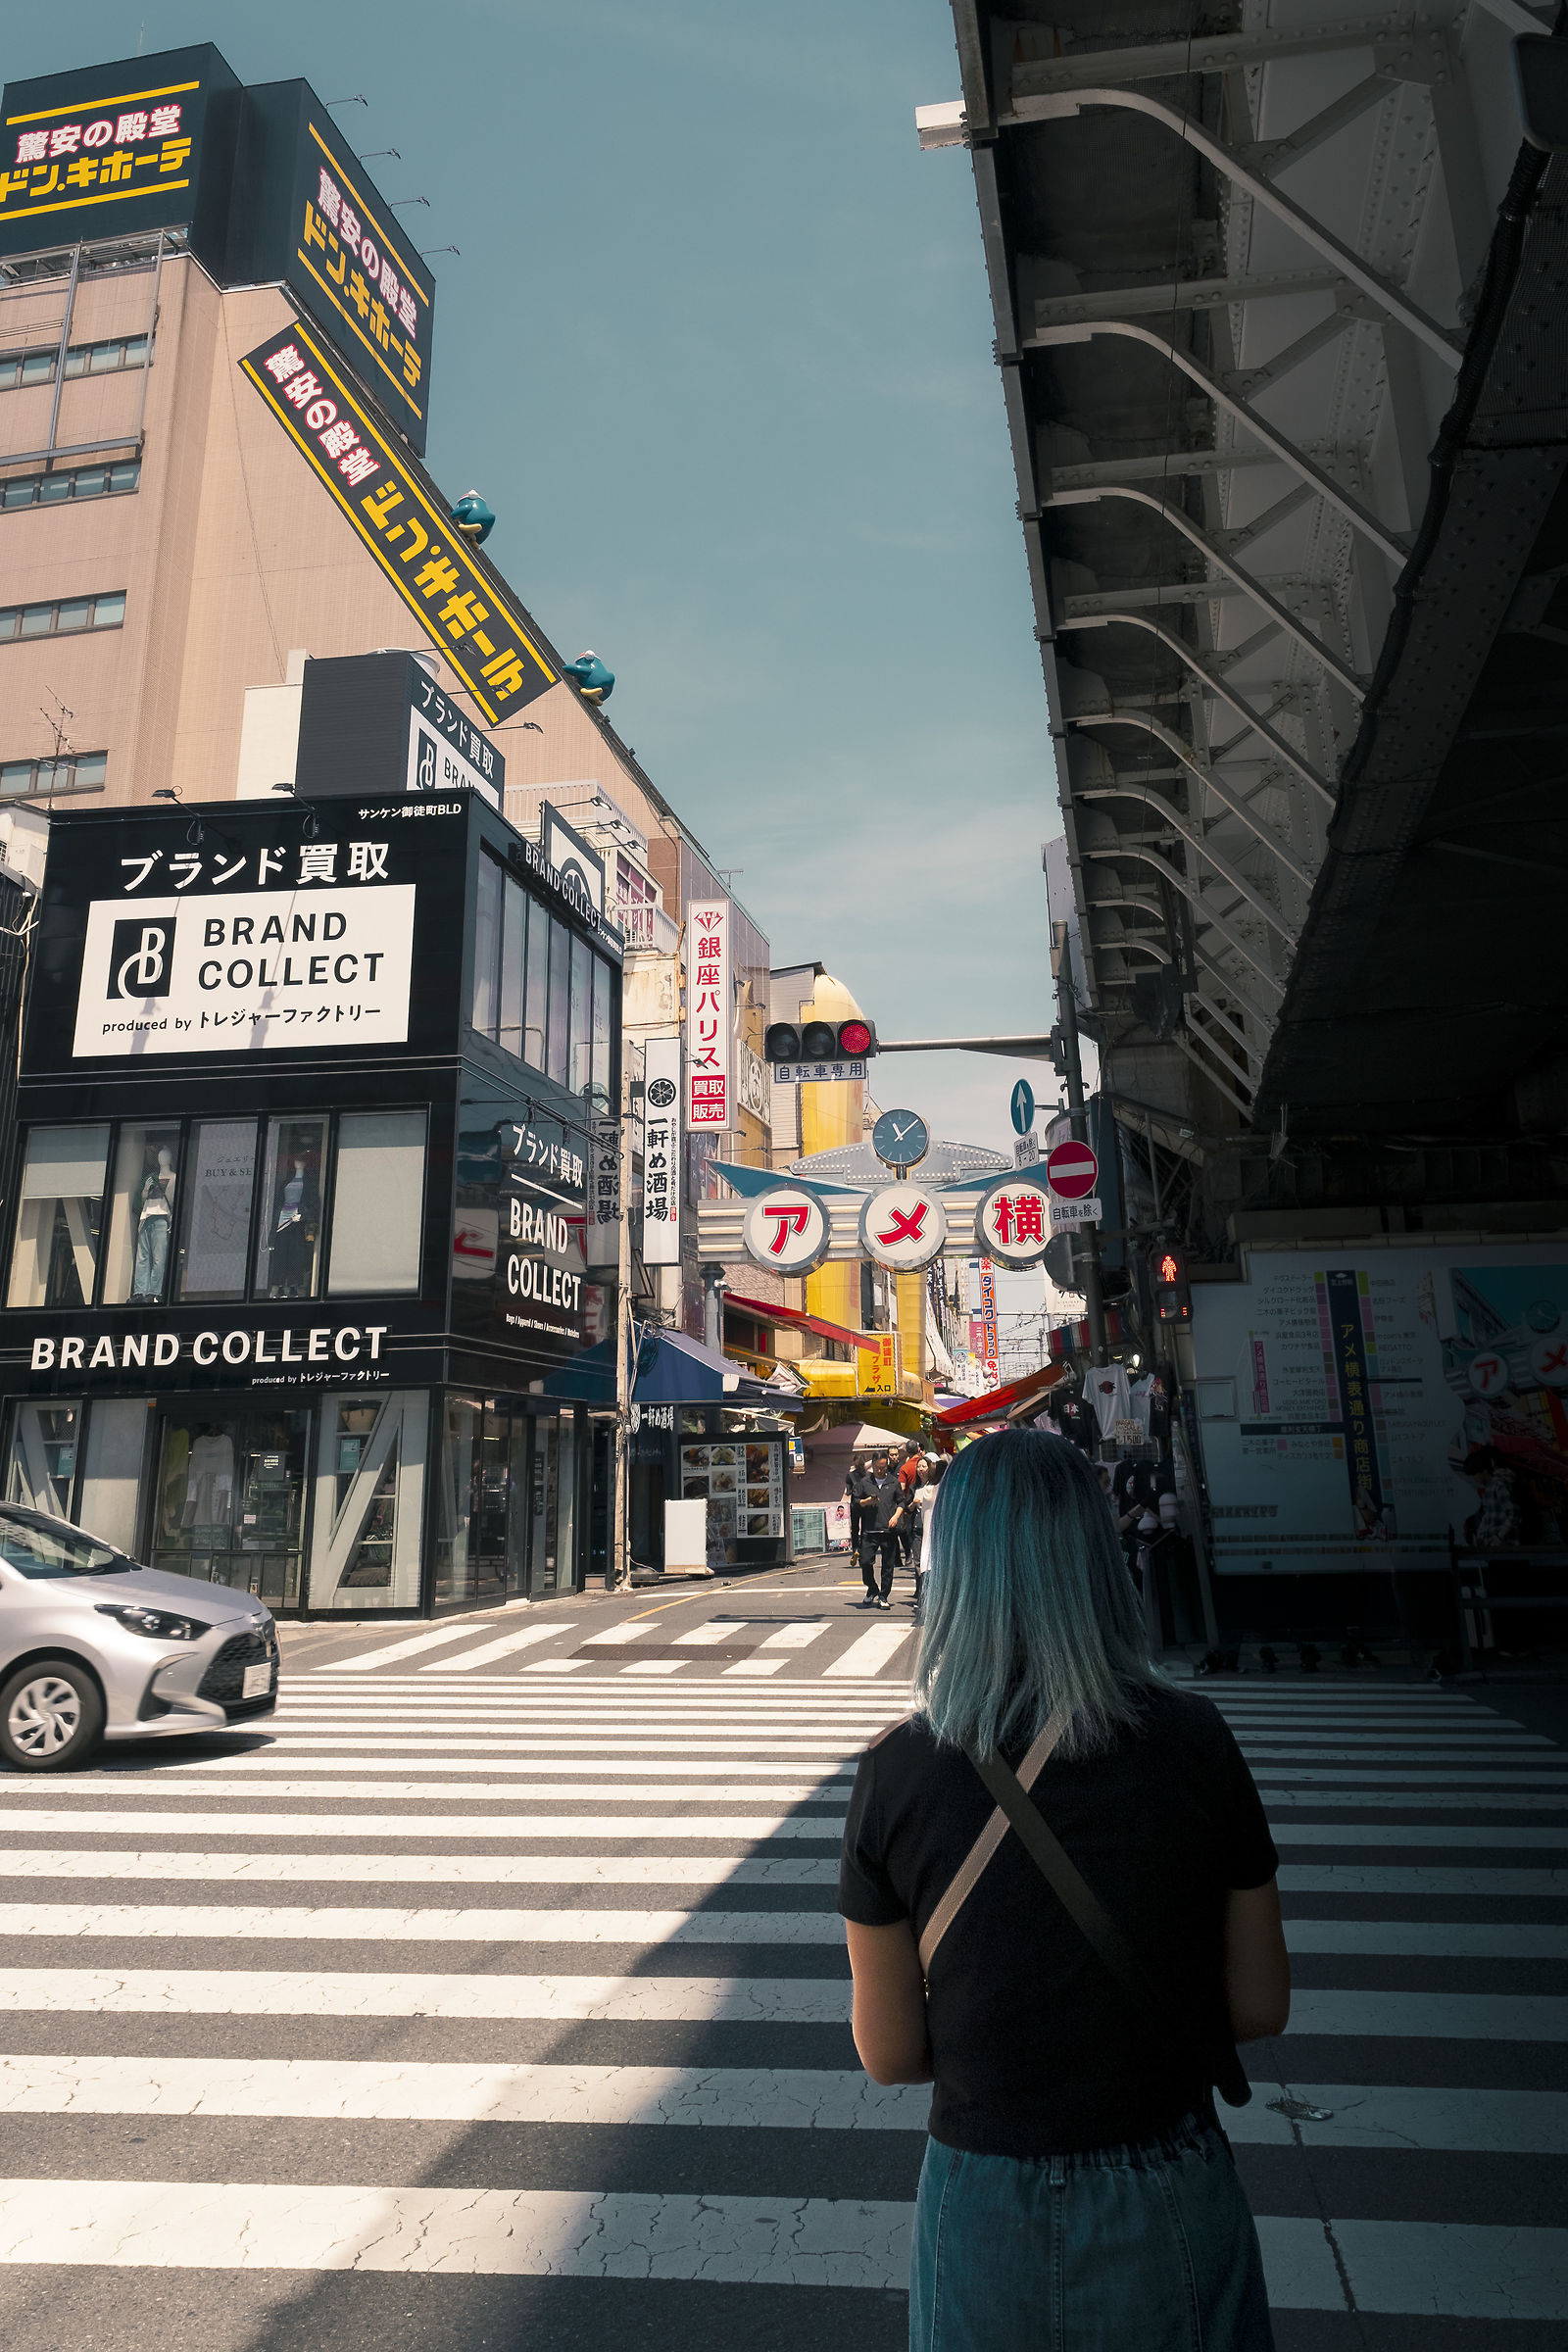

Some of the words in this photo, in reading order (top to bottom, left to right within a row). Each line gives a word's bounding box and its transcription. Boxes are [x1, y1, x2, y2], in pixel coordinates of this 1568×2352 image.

[16, 104, 181, 164] 驚安の殿堂
[318, 167, 418, 341] 驚安の殿堂
[265, 343, 381, 488] 驚安の殿堂
[420, 680, 494, 779] ブランド買取
[358, 803, 463, 820] サンケン御徒町BLD
[120, 841, 391, 891] ブランド買取
[525, 845, 561, 893] BRAND
[562, 877, 603, 930] COLLECT
[203, 911, 348, 947] BRAND
[198, 953, 384, 990] COLLECT
[102, 1016, 169, 1035] produced
[174, 1016, 192, 1033] by
[200, 1004, 382, 1030] トレジャーファクトリー
[695, 936, 722, 1069] 銀座パリス
[693, 1079, 724, 1097] 買取
[779, 1061, 863, 1080] 自転車専用
[692, 1102, 724, 1121] 販売
[205, 1168, 227, 1177] BUY
[513, 1124, 584, 1190] ブランド買取
[646, 1117, 668, 1222] 一軒め酒場
[510, 1198, 568, 1254] BRAND
[1053, 1203, 1098, 1220] 自転車を除く
[508, 1253, 581, 1311] COLLECT
[30, 1332, 181, 1370] BRAND
[192, 1326, 388, 1366] COLLECT
[252, 1376, 286, 1386] produced
[288, 1376, 297, 1385] by
[299, 1370, 390, 1383] トレジャーファクトリー
[876, 1384, 891, 1393] 入口
[1341, 1323, 1372, 1491] アメ横表通り商店街
